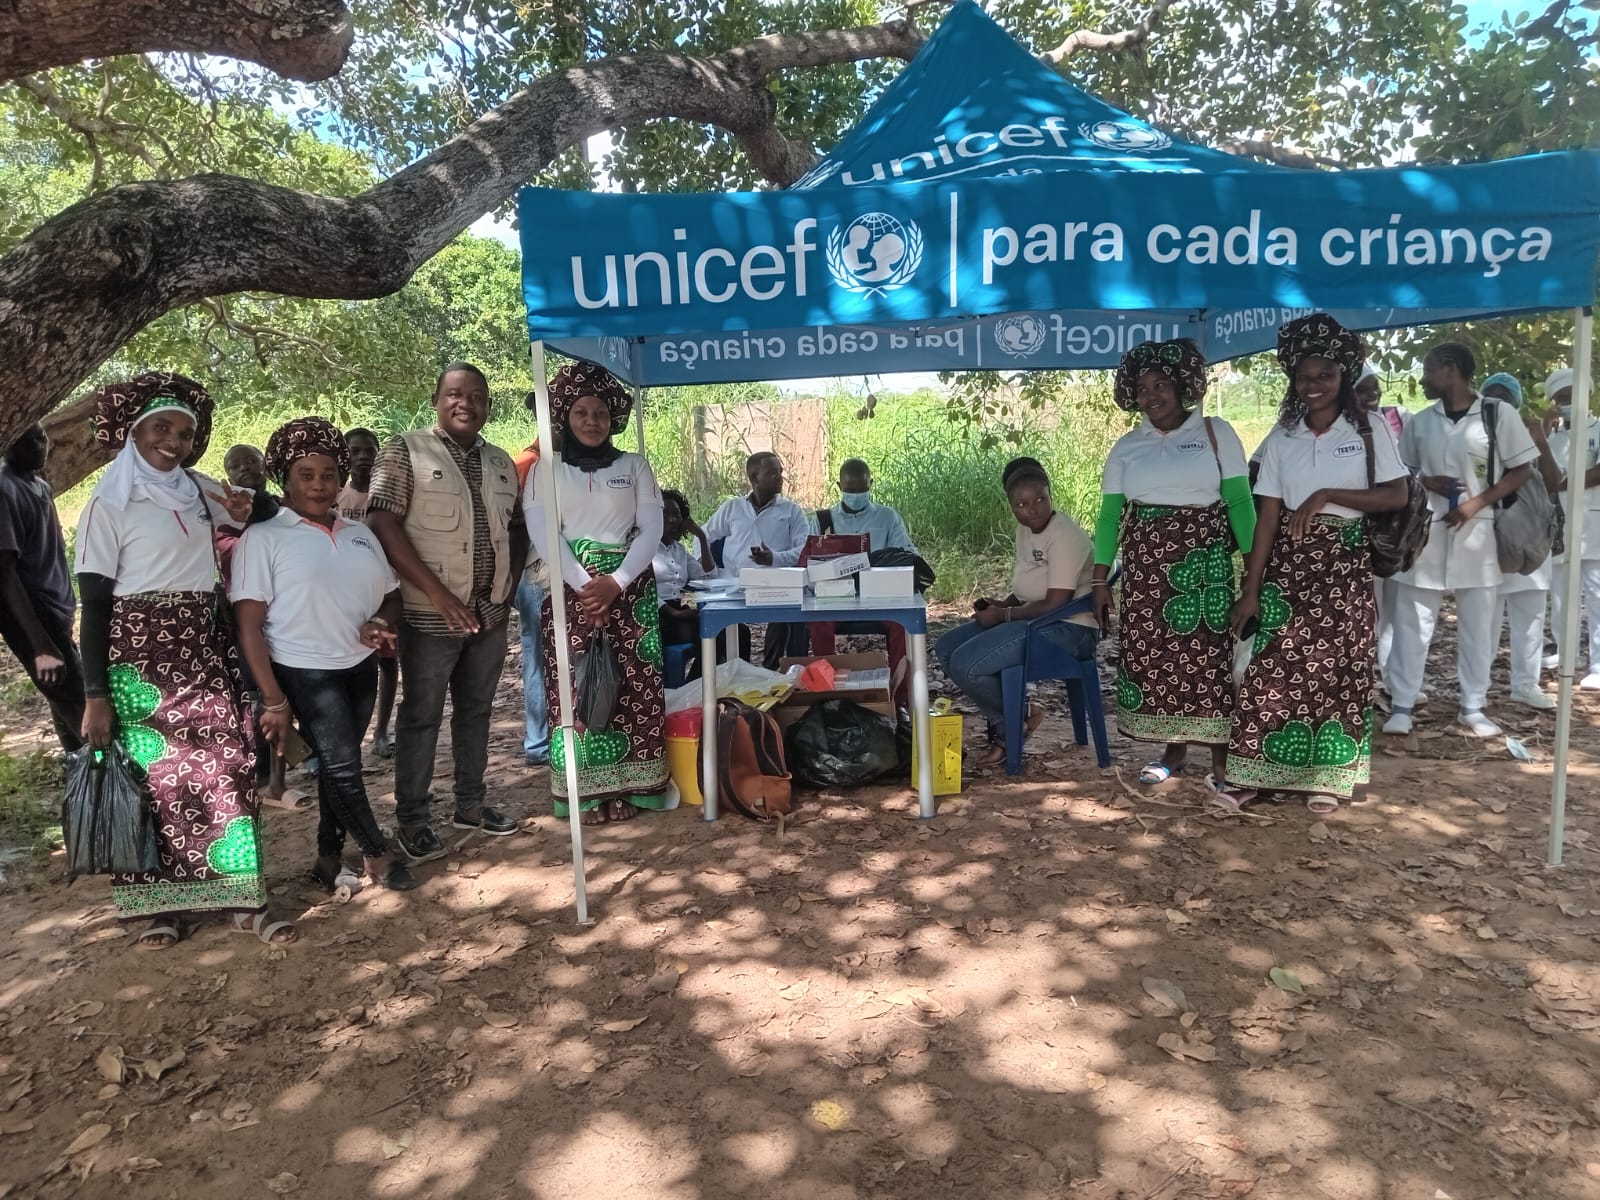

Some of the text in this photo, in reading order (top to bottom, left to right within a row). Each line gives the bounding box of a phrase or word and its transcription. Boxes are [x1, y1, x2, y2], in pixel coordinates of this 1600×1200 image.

[841, 117, 1068, 186] unicef
[571, 218, 817, 310] unicef
[982, 209, 1553, 285] para cada criança
